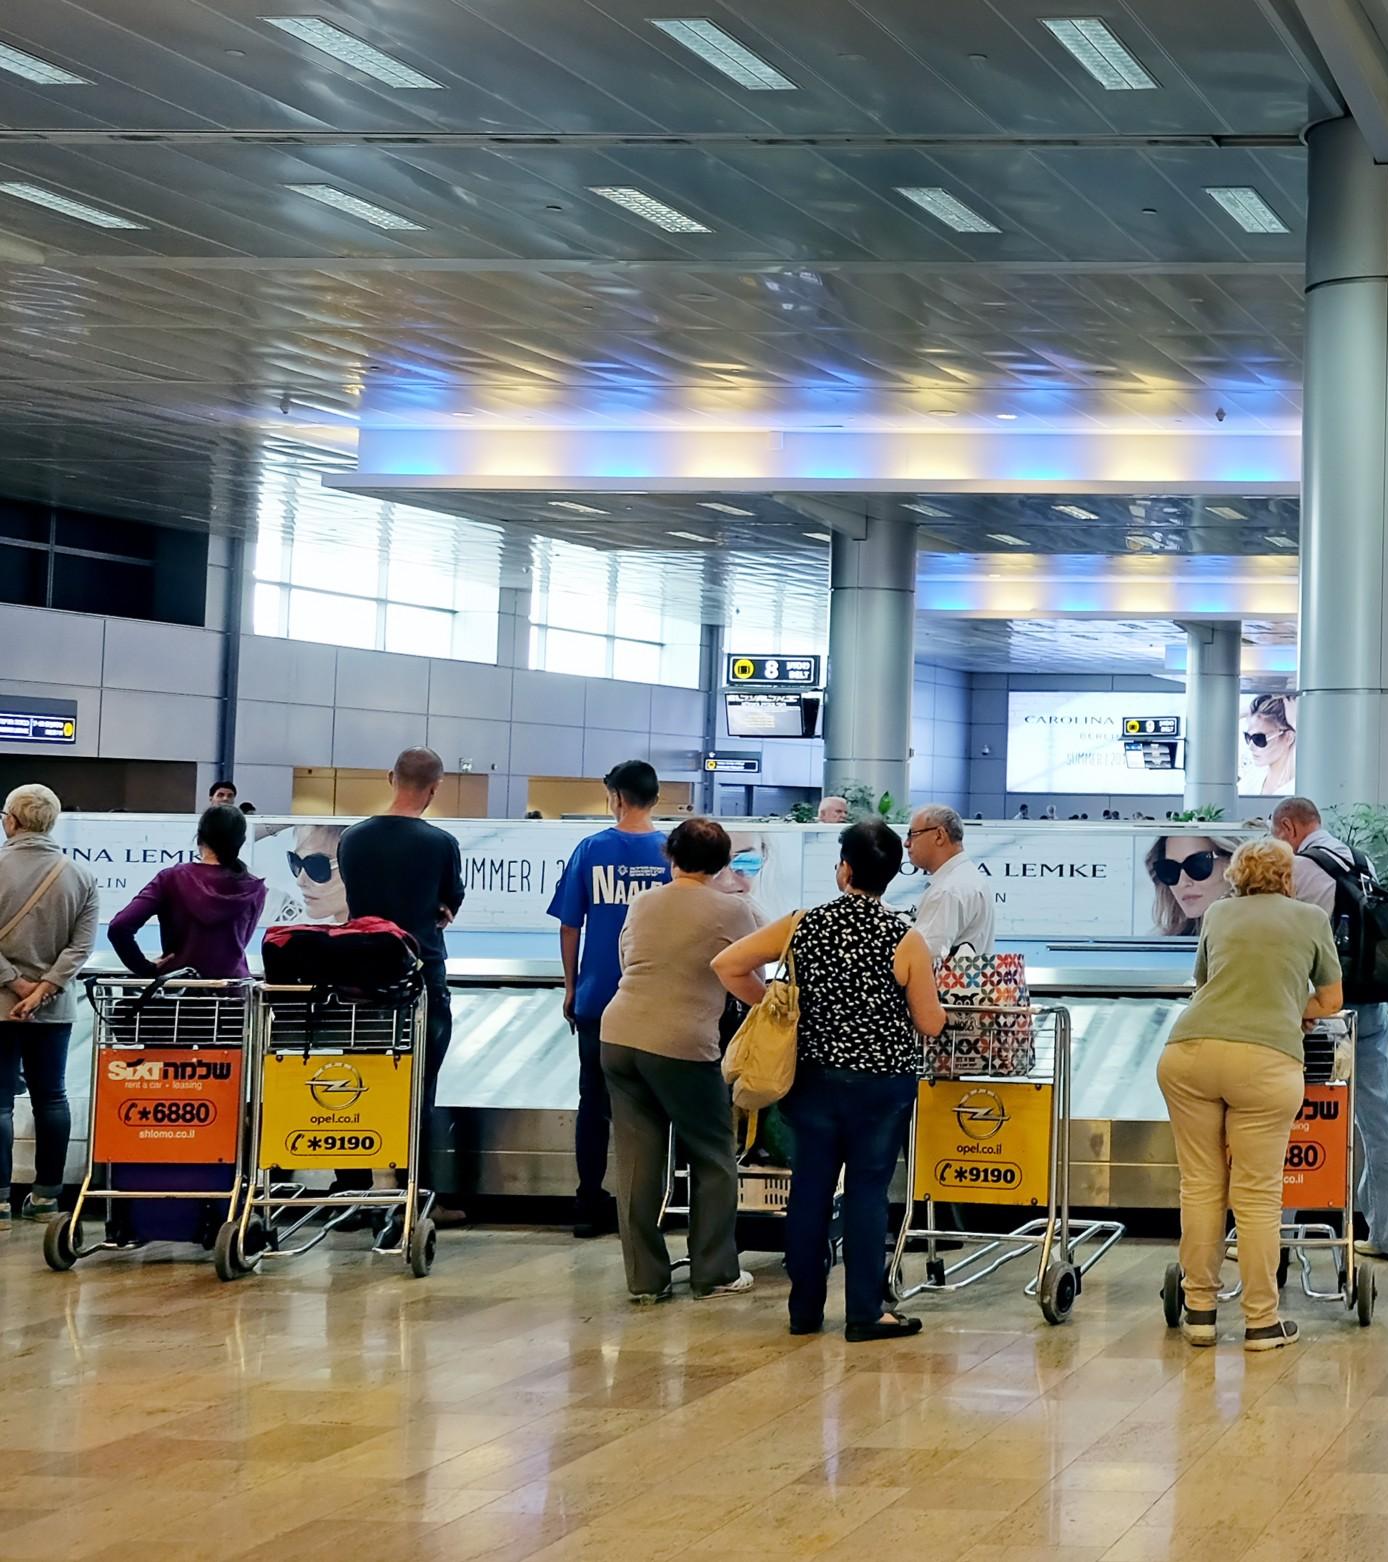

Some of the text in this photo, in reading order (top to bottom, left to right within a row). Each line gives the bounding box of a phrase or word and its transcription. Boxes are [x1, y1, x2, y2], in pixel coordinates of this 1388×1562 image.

[764, 660, 779, 679] 8
[1023, 714, 1115, 725] CAROLINA
[125, 848, 202, 863] LEMK
[1004, 862, 1108, 879] LEMKE
[162, 1060, 231, 1081] שלמה
[310, 1113, 360, 1125] opel.co.il
[139, 1129, 195, 1139] shlomo.co.il
[956, 1143, 1002, 1155] opel.co.il
